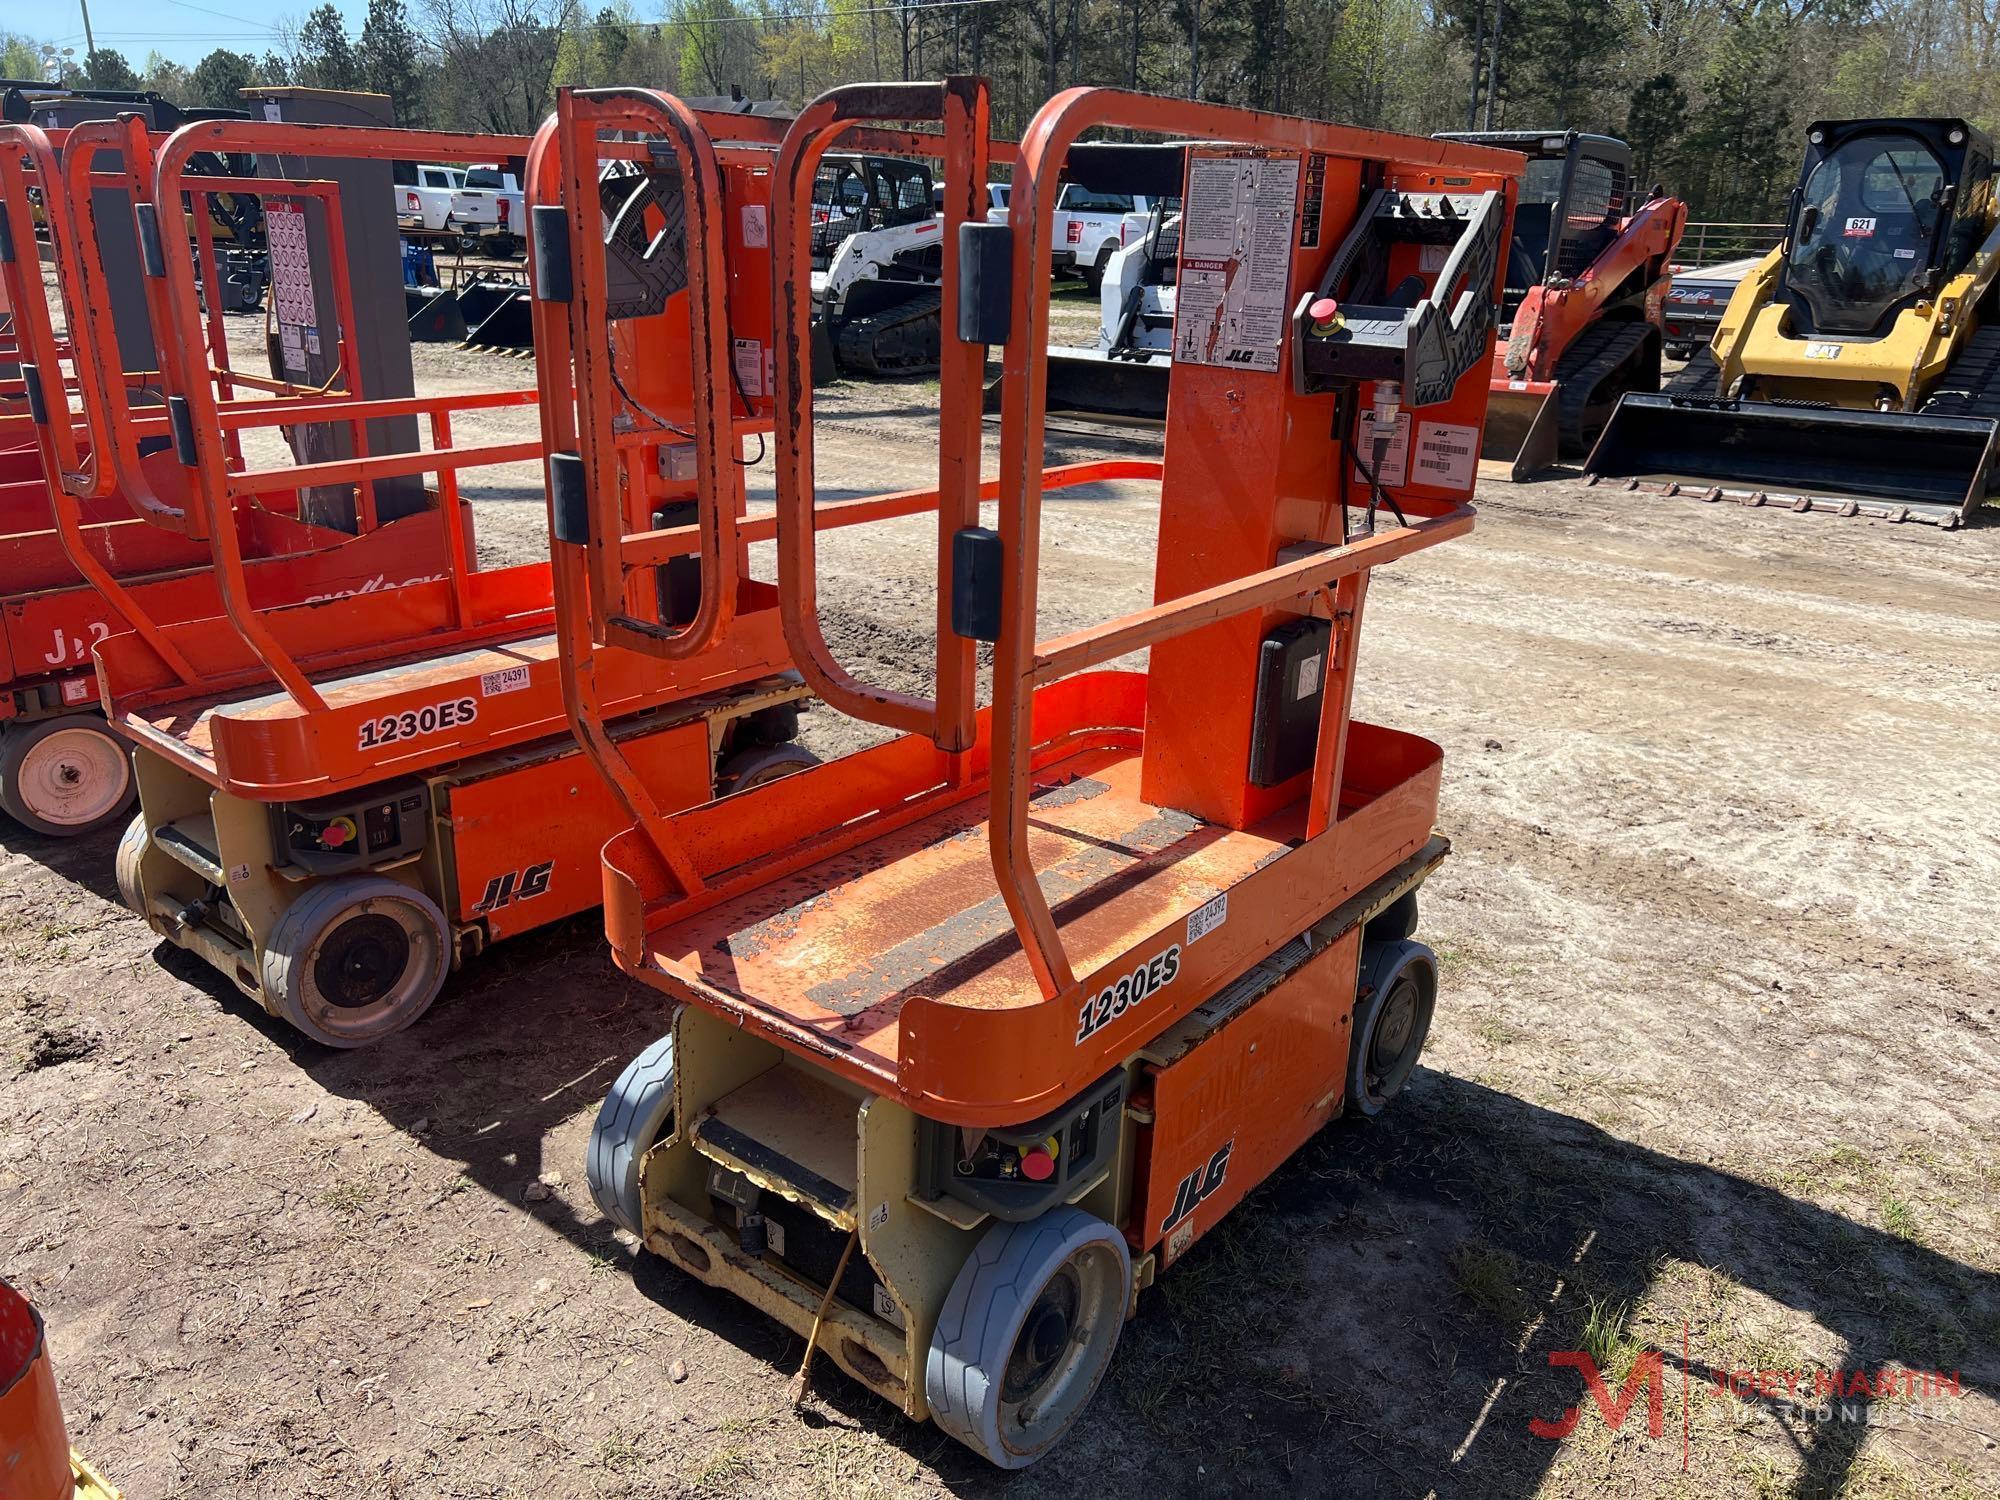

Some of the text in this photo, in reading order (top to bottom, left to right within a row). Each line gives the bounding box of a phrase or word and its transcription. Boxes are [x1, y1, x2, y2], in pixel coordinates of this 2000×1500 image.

[1851, 218, 1871, 230] 621
[1194, 261, 1224, 270] DANGER
[1668, 288, 1713, 300] Delta
[1224, 349, 1256, 363] JLG
[1362, 412, 1376, 422] JL
[502, 668, 527, 684] 24391
[359, 697, 478, 751] 1230ES
[471, 859, 555, 914] JLG
[1204, 896, 1226, 922] 24392
[1075, 944, 1182, 1046] 1230ES
[1159, 1137, 1235, 1235] JLG
